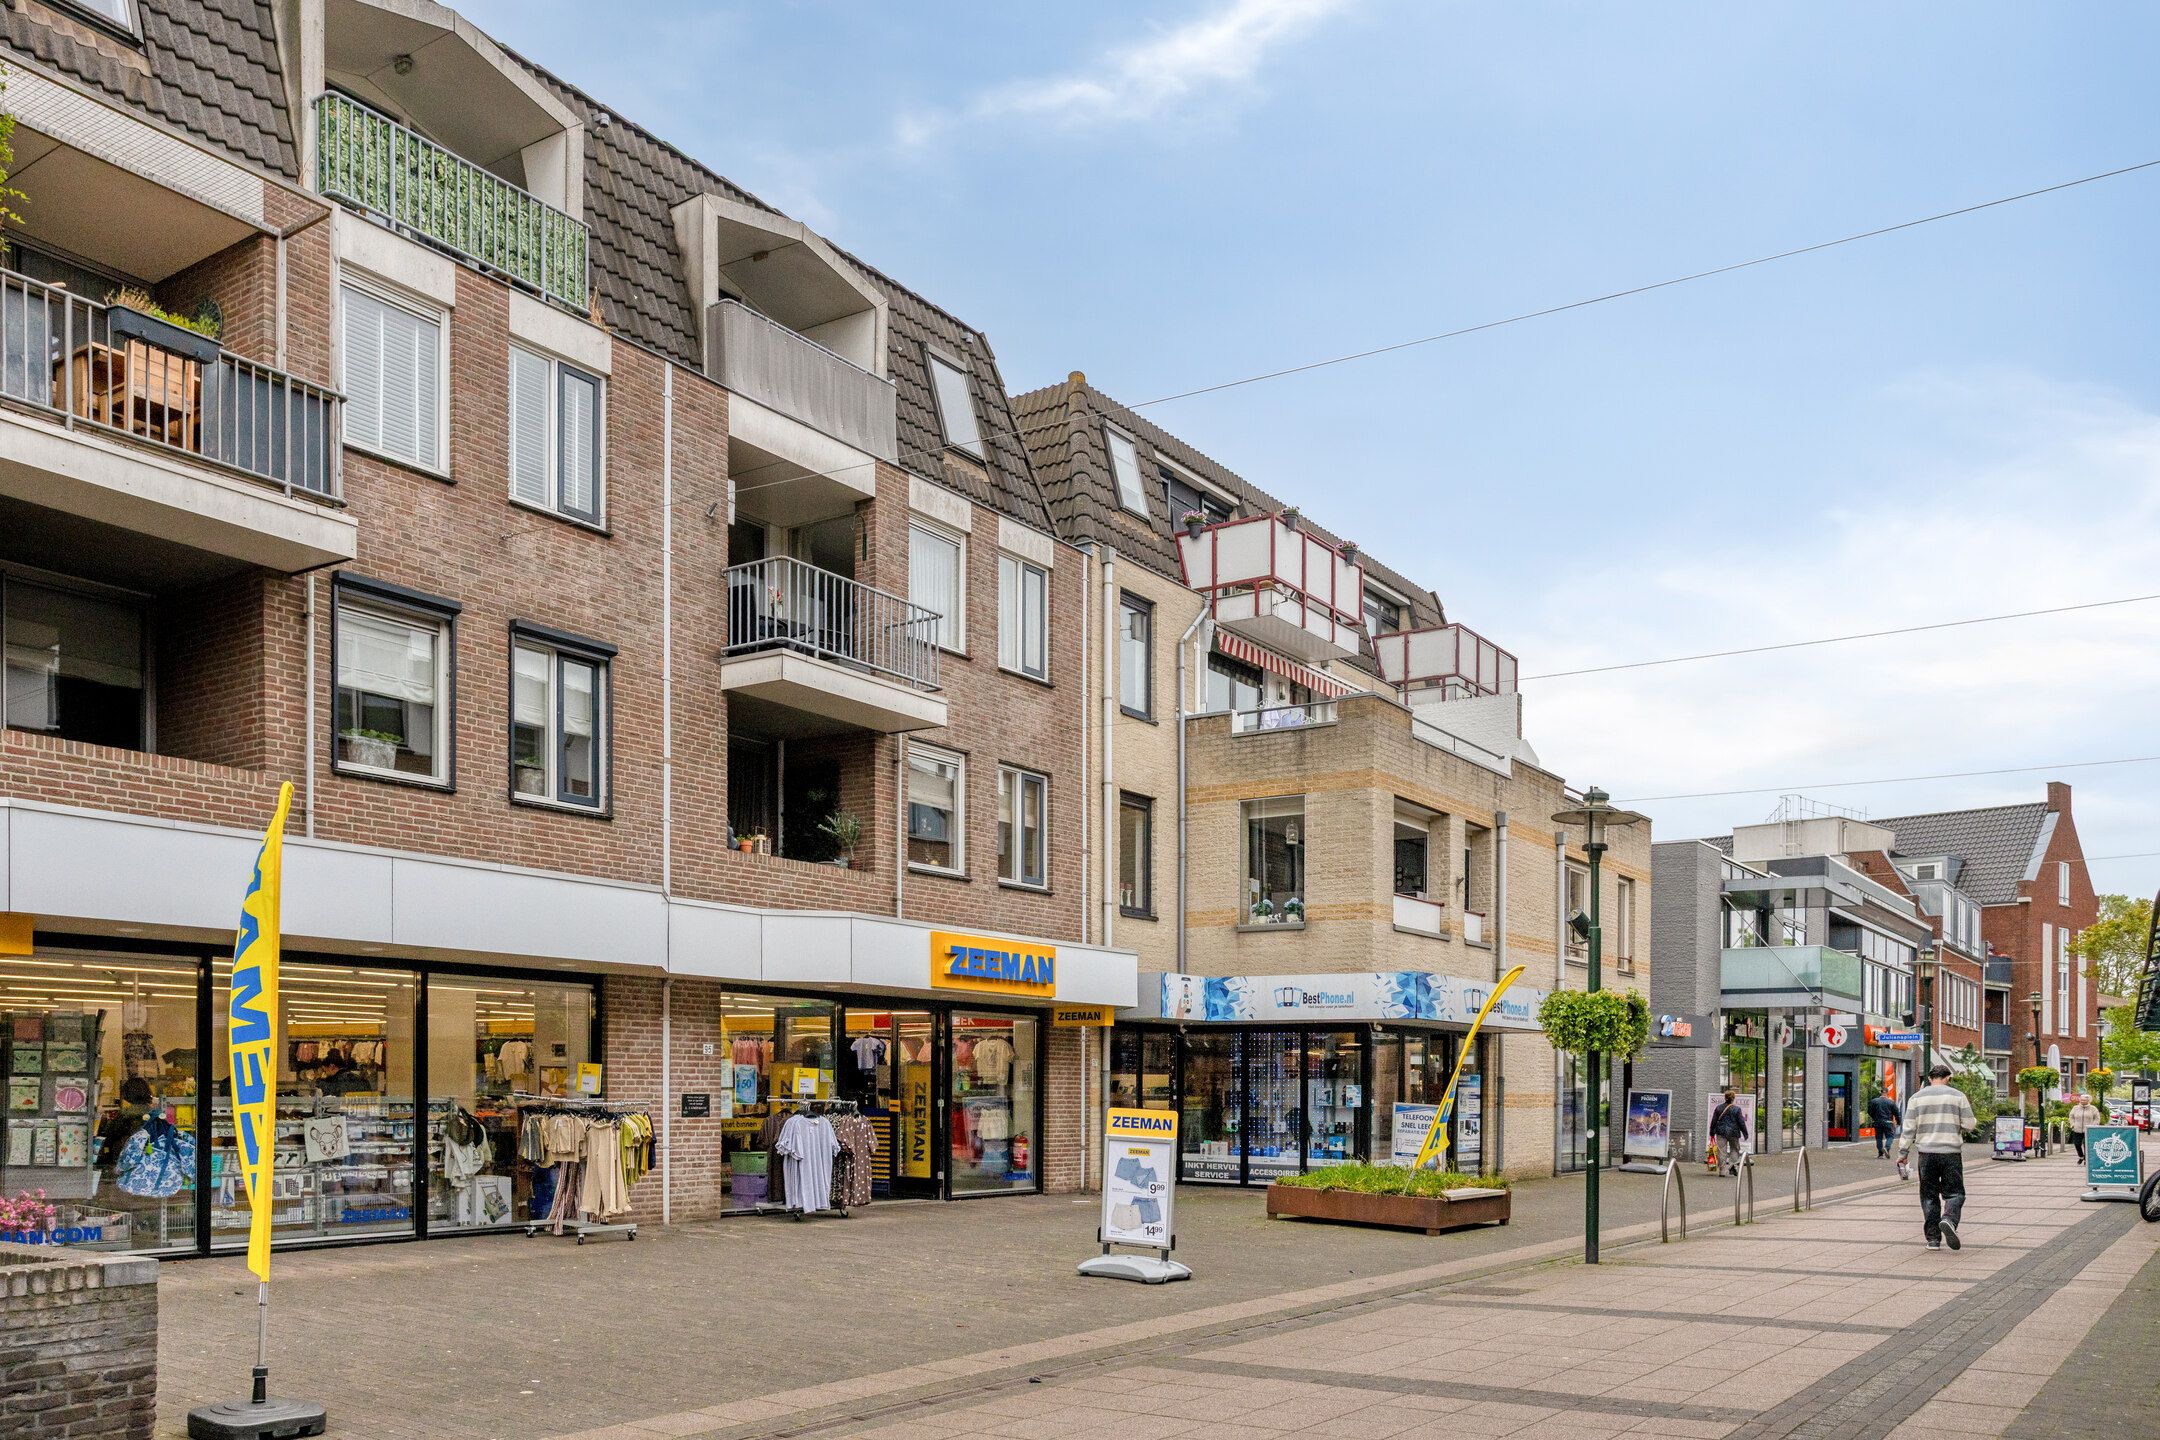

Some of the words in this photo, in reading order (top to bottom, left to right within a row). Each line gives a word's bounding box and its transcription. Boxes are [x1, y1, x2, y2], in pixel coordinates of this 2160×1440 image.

[949, 945, 1054, 984] ZEEMAN
[1302, 991, 1354, 1004] BestPhone.nl
[1490, 1000, 1529, 1017] estPhone.nl
[1058, 1012, 1101, 1021] ZEEMAN
[705, 1045, 712, 1054] 95
[742, 1079, 752, 1089] 50
[913, 1081, 927, 1162] ZEEMAN
[1112, 1116, 1173, 1131] ZEEMAN
[1206, 1163, 1240, 1171] HERVUL
[1249, 1168, 1300, 1177] ACCESSOIRES
[1194, 1171, 1230, 1179] SERVICE
[341, 1206, 409, 1224] ZEEMAN
